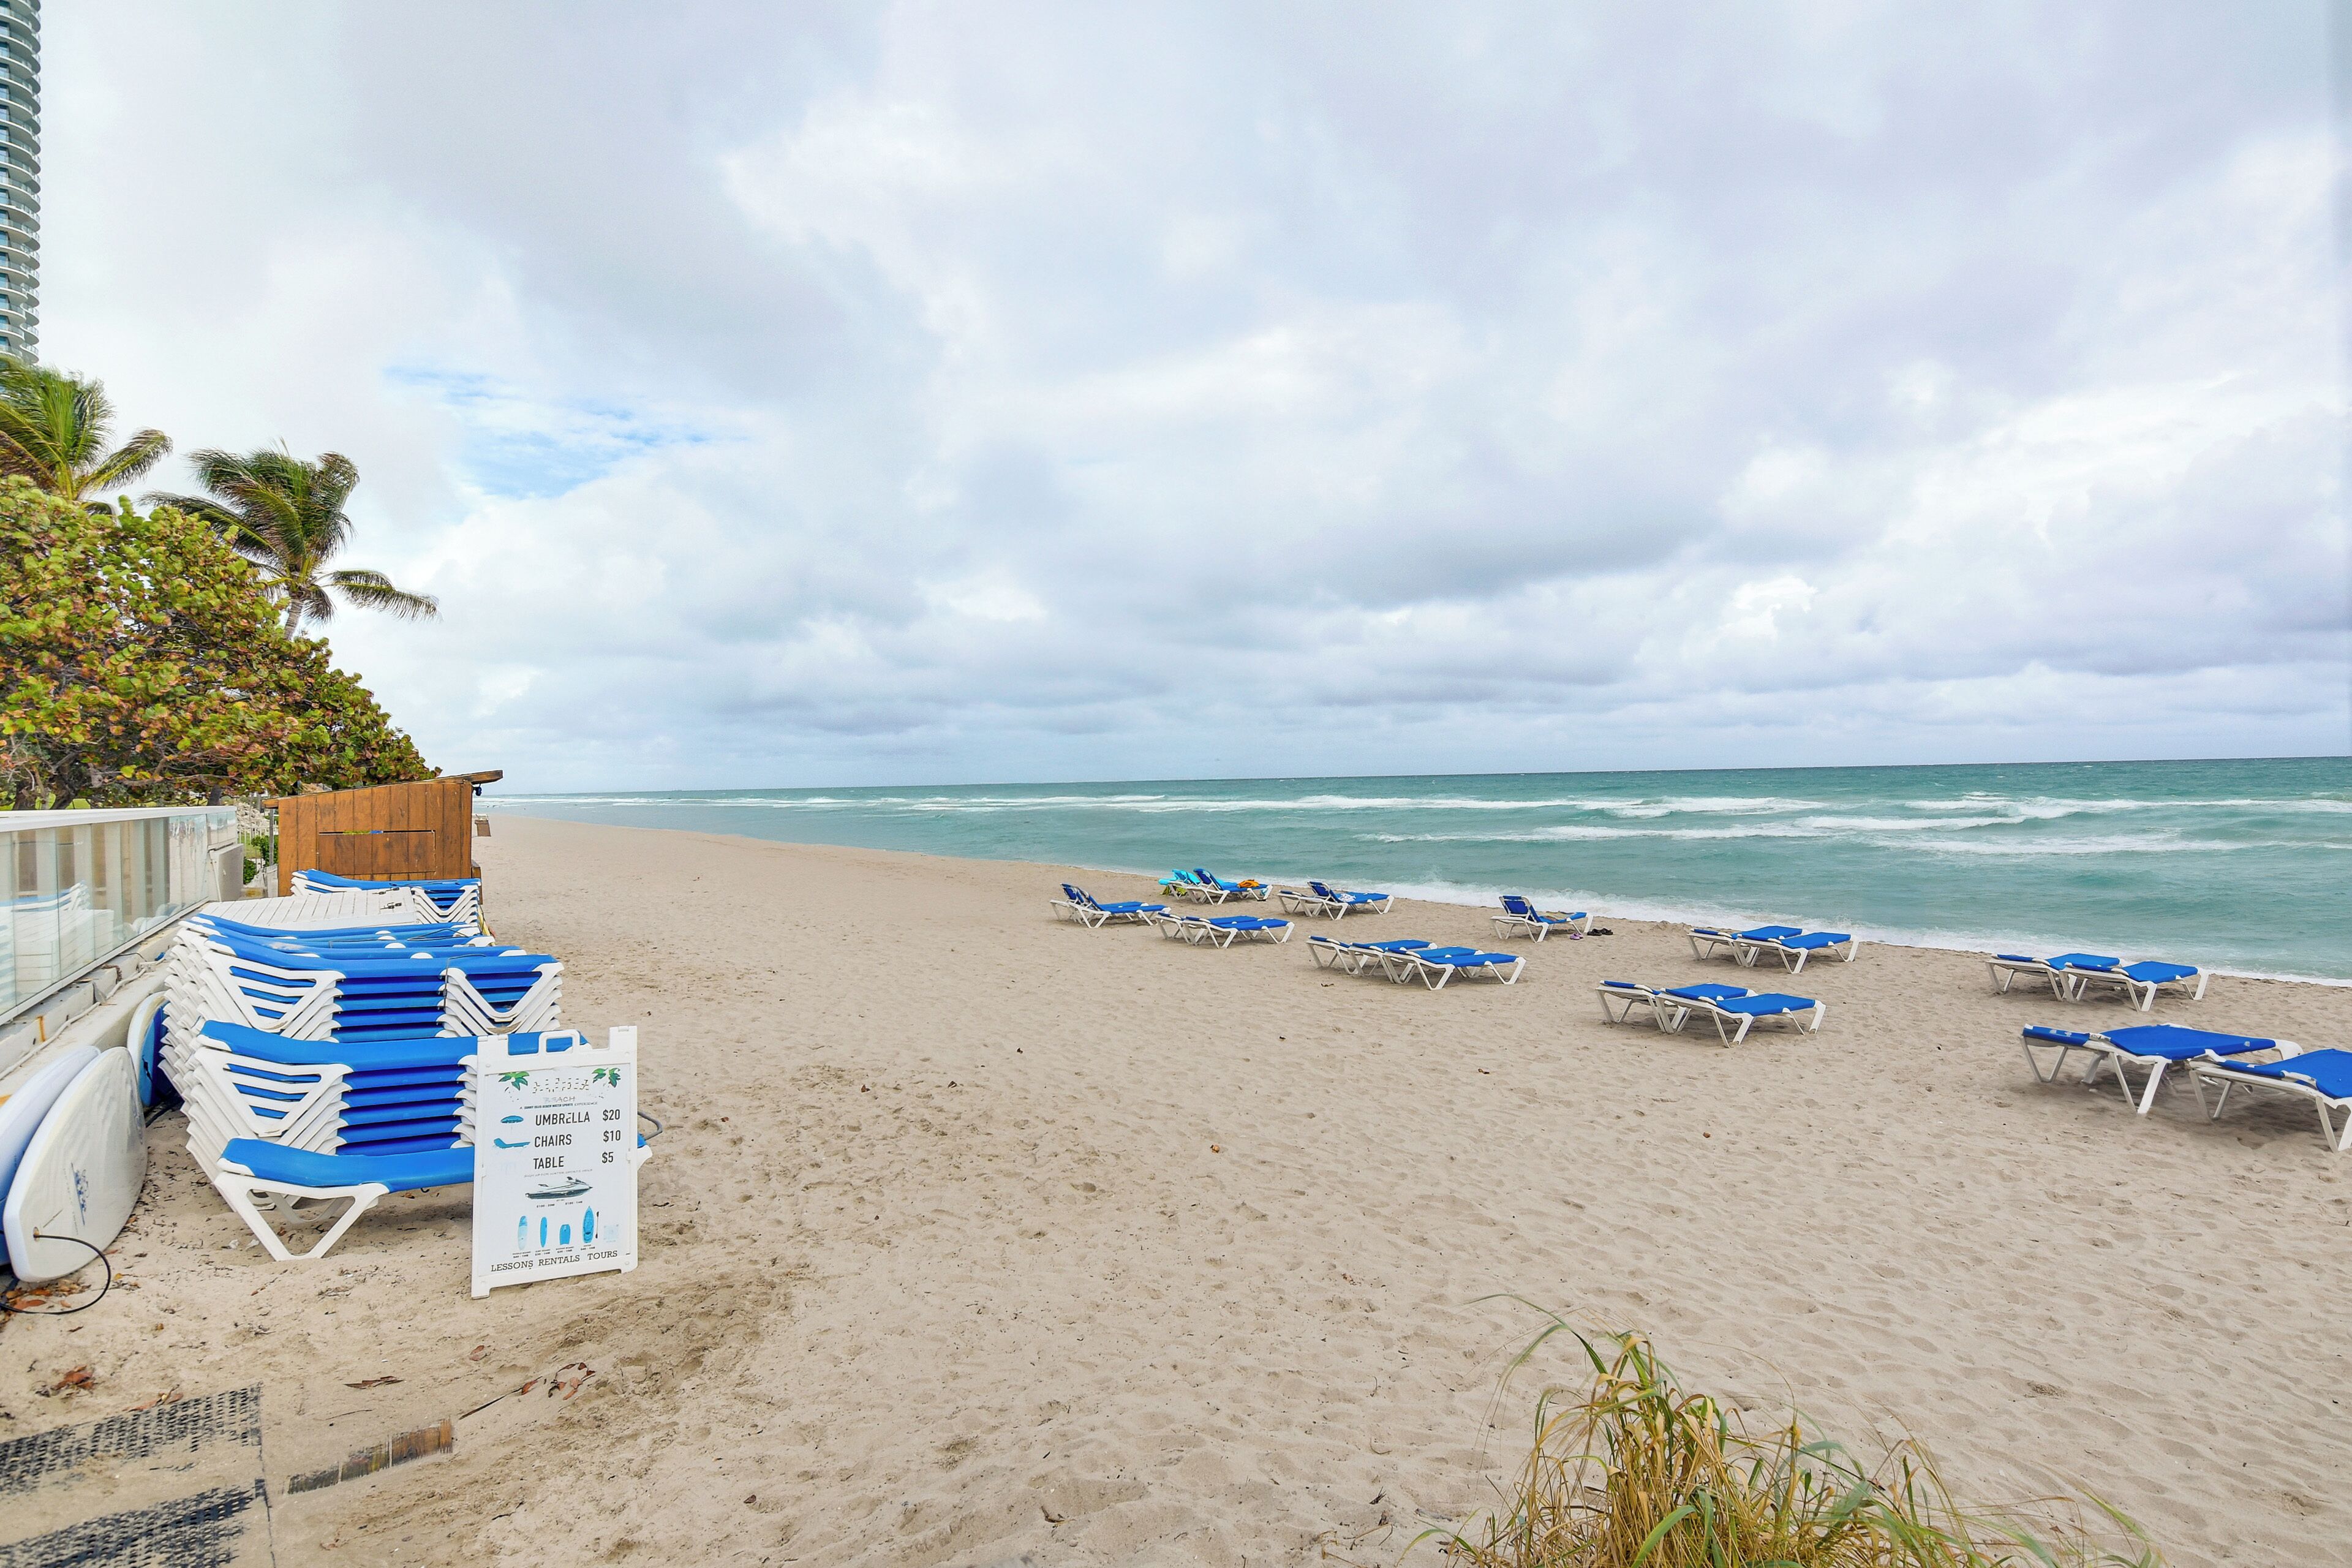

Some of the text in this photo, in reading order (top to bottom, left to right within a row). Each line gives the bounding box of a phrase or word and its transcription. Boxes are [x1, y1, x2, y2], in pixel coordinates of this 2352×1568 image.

[535, 1109, 620, 1126] UMBRELLA $20
[535, 1130, 621, 1148] CHAIRS $10
[533, 1152, 614, 1169] TABLE $5
[492, 1251, 618, 1272] LESSONS RENTALS TOURS
